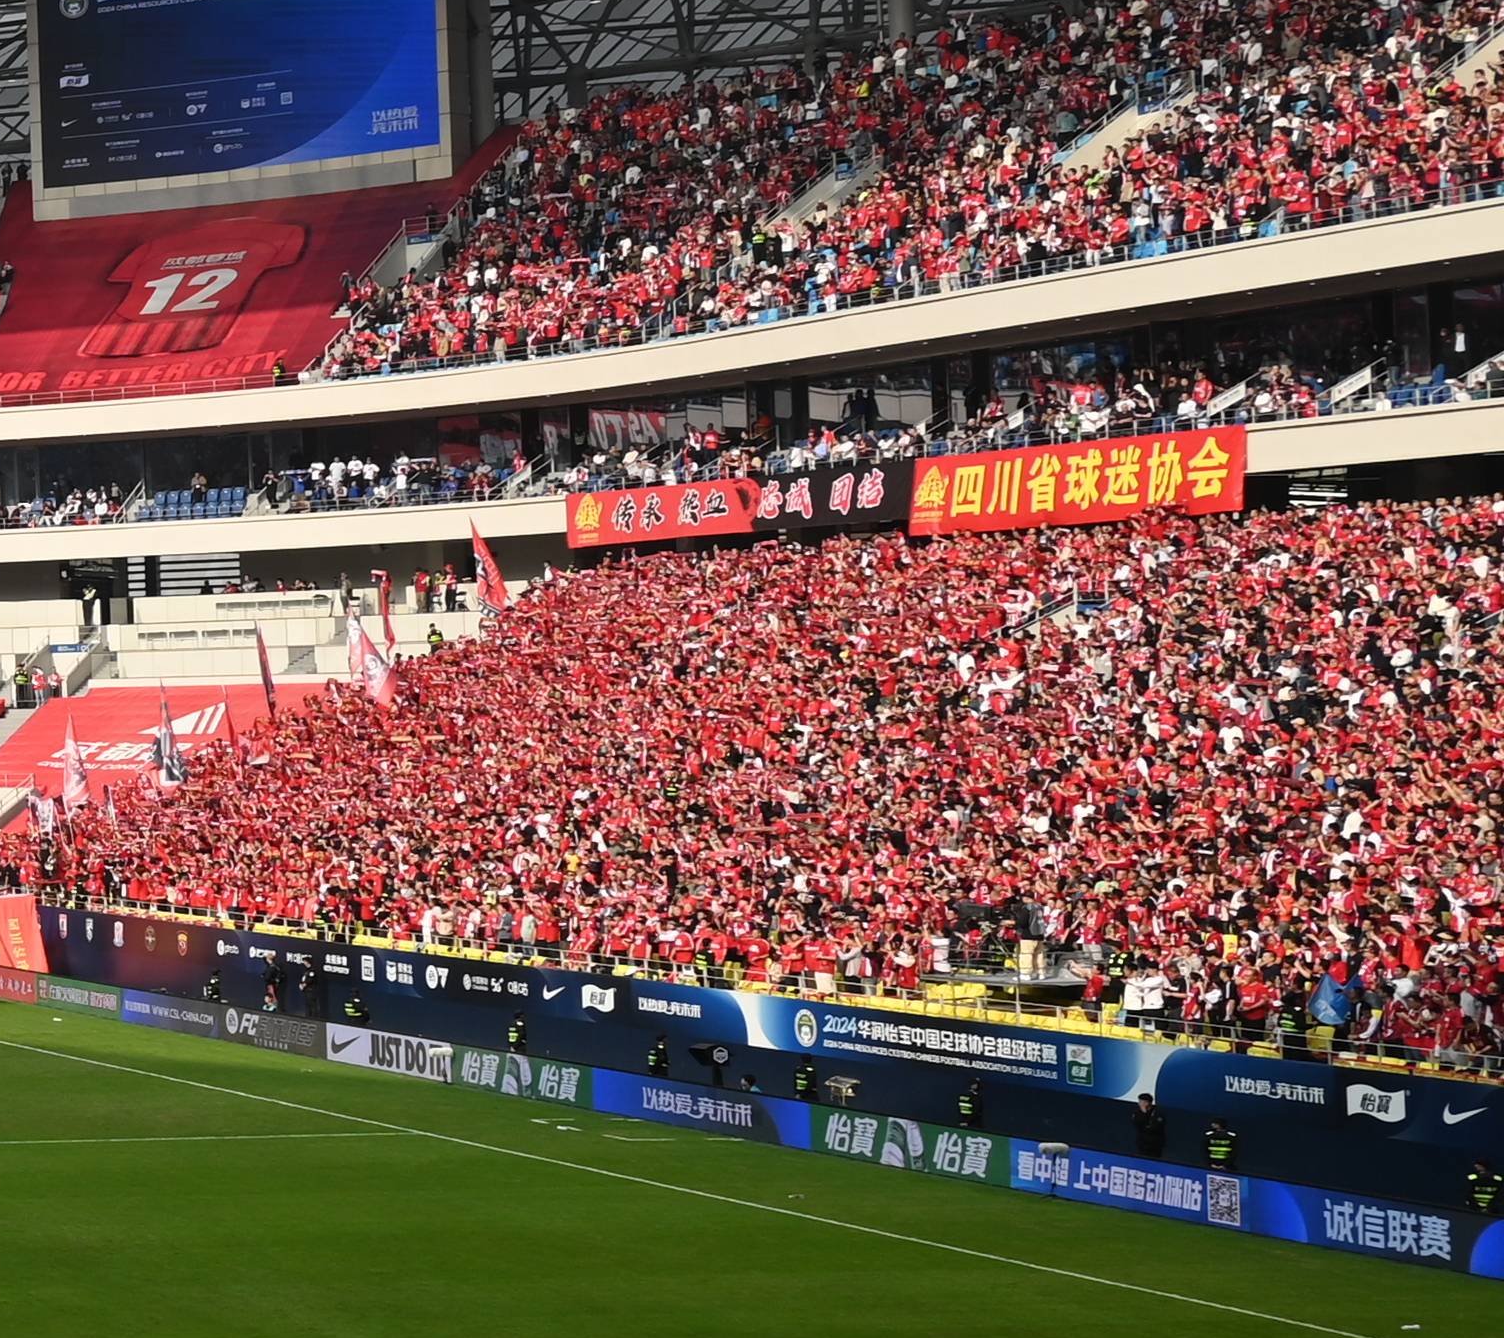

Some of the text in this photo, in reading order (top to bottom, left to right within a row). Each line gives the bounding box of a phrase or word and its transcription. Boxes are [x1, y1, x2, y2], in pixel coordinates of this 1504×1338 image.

[138, 267, 239, 315] 12
[60, 363, 183, 390] BETTER
[198, 348, 288, 380] CITY
[611, 468, 886, 533] 传承 热血 忠诚 团结
[950, 436, 1231, 518] 四川省球迷协会
[239, 1013, 260, 1036] FC
[822, 1014, 1058, 1065] 2024华润怡宝中国足球协会超级联赛
[369, 1033, 402, 1069] JUST
[404, 1040, 427, 1072] DO
[461, 1050, 580, 1102] 怡寶 怡寶
[1360, 1092, 1393, 1116] 怡寶
[825, 1112, 992, 1178] 怡寶 怡寶
[1017, 1150, 1203, 1212] 看中超 上中国移动咪咕
[1323, 1198, 1452, 1262] 诚信联赛
